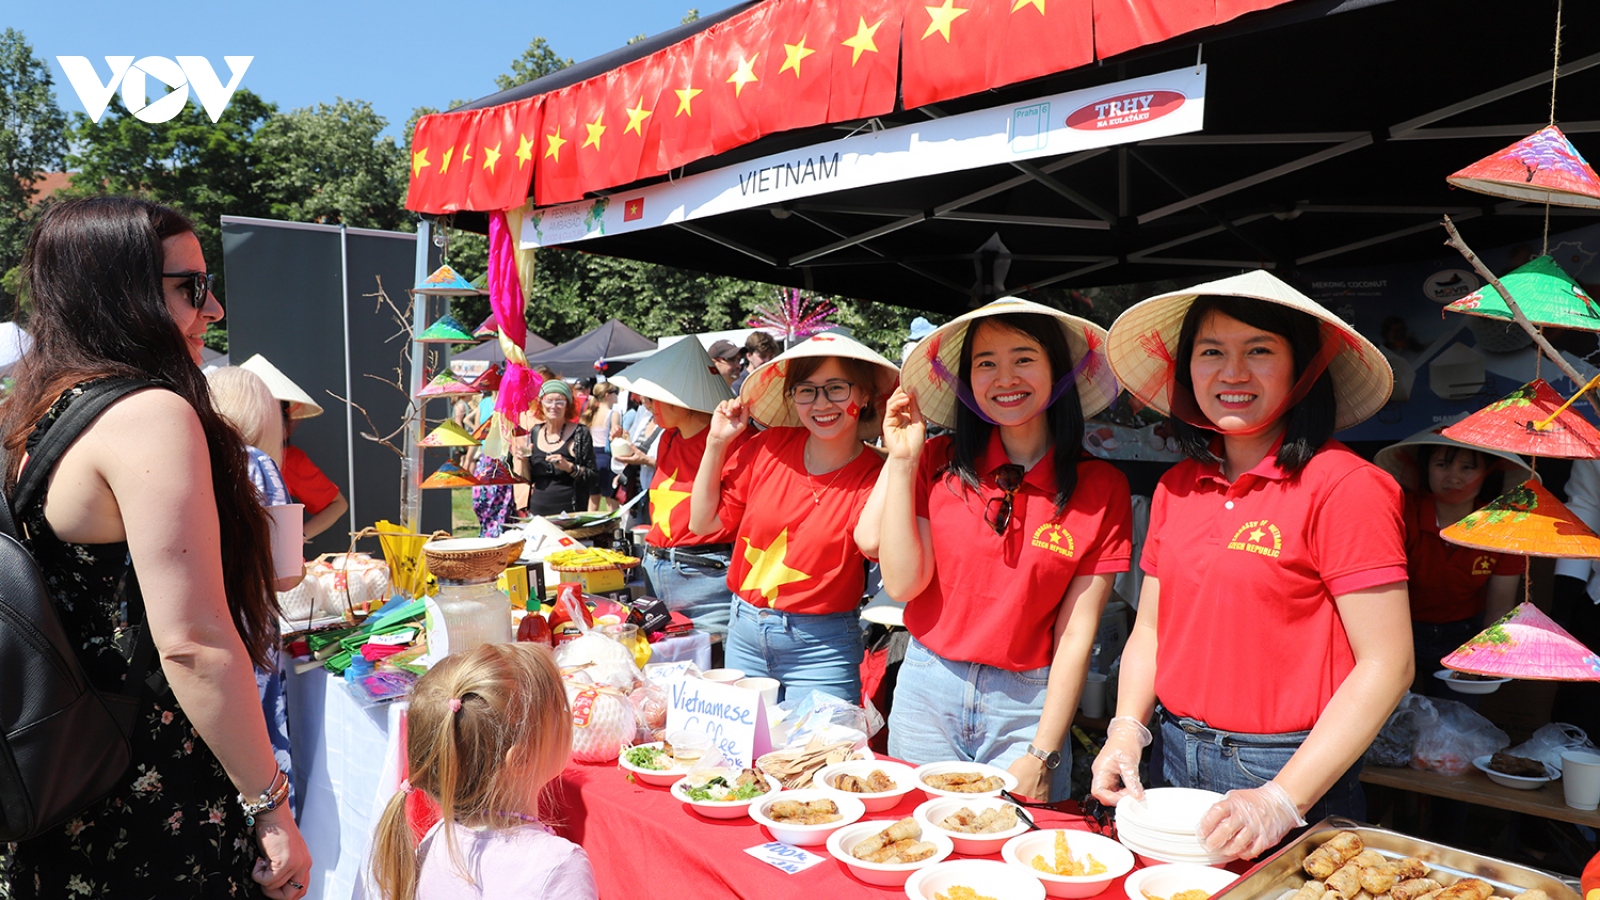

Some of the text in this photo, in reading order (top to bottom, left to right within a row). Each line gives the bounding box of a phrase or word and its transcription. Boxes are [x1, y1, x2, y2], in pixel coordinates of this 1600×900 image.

[1016, 105, 1048, 118] Praha 6
[1095, 94, 1154, 120] TRHY
[1096, 120, 1108, 128] NA
[739, 152, 839, 196] VIETNAM
[551, 206, 581, 219] FESTIVAL
[1312, 280, 1387, 289] MEKONG COCONUT
[1031, 539, 1075, 558] CZECH REPUBLIC
[1227, 541, 1281, 558] CZECH REPUBLIC
[673, 680, 753, 725] Vietnamese
